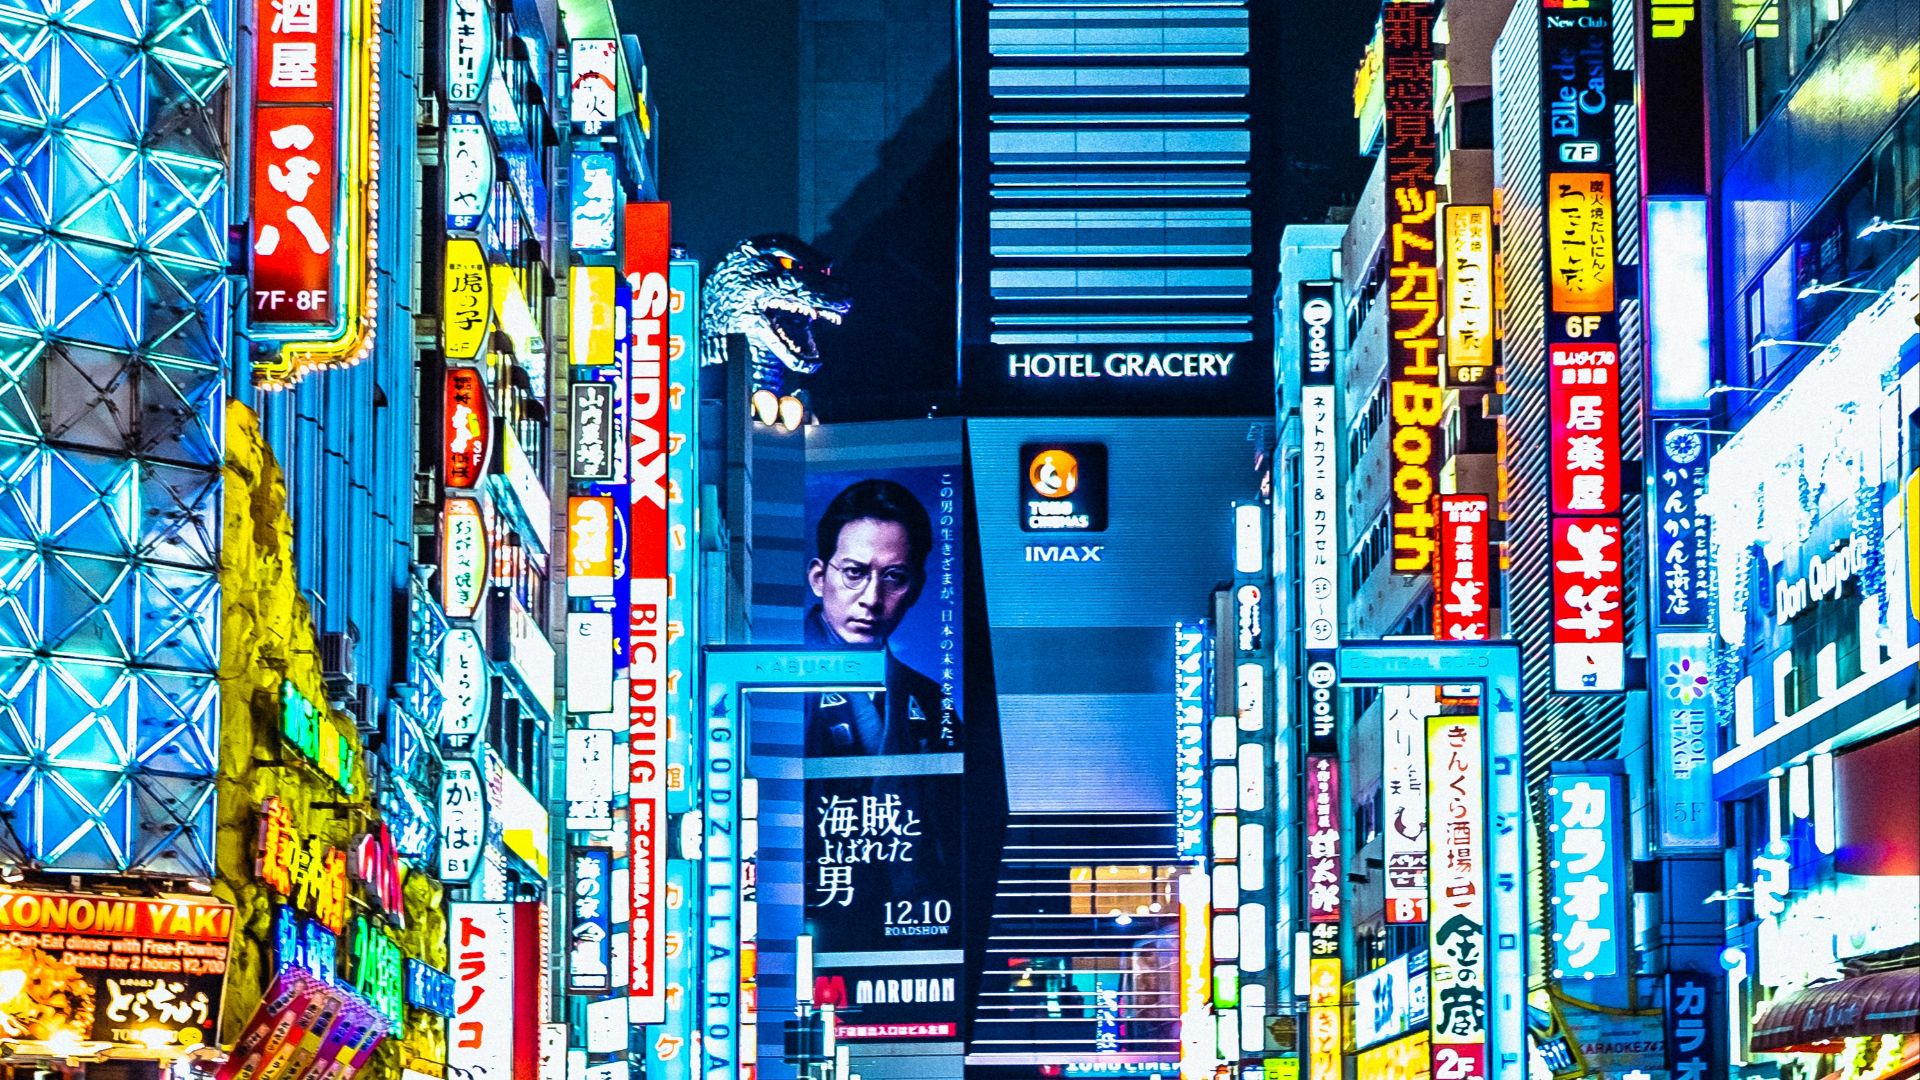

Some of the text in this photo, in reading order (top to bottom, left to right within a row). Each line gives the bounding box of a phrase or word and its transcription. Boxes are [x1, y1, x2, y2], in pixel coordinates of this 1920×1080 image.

[1547, 16, 1607, 28] New Club
[452, 83, 479, 98] 6F
[1552, 48, 1579, 137] Elle de
[1564, 146, 1595, 160] 7F
[454, 216, 472, 227] 5F
[1566, 316, 1601, 338] 6F
[1008, 353, 1234, 378] HOTEL GRACERY
[1457, 367, 1484, 382] 6F
[630, 272, 667, 509] SHIDAX
[1566, 395, 1606, 510] 居楽屋
[1026, 546, 1101, 561] IMAX
[1777, 577, 1806, 626] Don
[630, 604, 657, 783] BIC DRUG
[448, 735, 469, 747] 1F
[1673, 709, 1688, 776] STAGE
[1690, 710, 1705, 763] IDOL
[1447, 726, 1471, 873] きんくら酒場
[1673, 802, 1704, 822] 5F
[817, 793, 922, 838] 海賊と
[709, 728, 732, 959] GODZILLA
[817, 837, 913, 864] よばれた
[448, 858, 469, 873] B1
[1561, 781, 1611, 969] カラオケ
[816, 866, 854, 907] 男
[148, 903, 232, 938] YAKI
[884, 899, 952, 925] 12.10
[1395, 900, 1428, 921] B1
[885, 925, 950, 937] ROADSHOW
[1312, 924, 1338, 938] 4F
[66, 936, 110, 952] dinner
[112, 938, 141, 955] with
[1312, 940, 1338, 954] 3F
[63, 951, 108, 968] Drinks
[108, 954, 129, 970] for
[130, 956, 140, 970] 2
[142, 955, 181, 972] hours
[457, 917, 486, 1049] トラノコ
[1436, 914, 1484, 1037] 金の蔵
[856, 977, 955, 1004] MARUHAN
[1436, 1048, 1476, 1080] 2F
